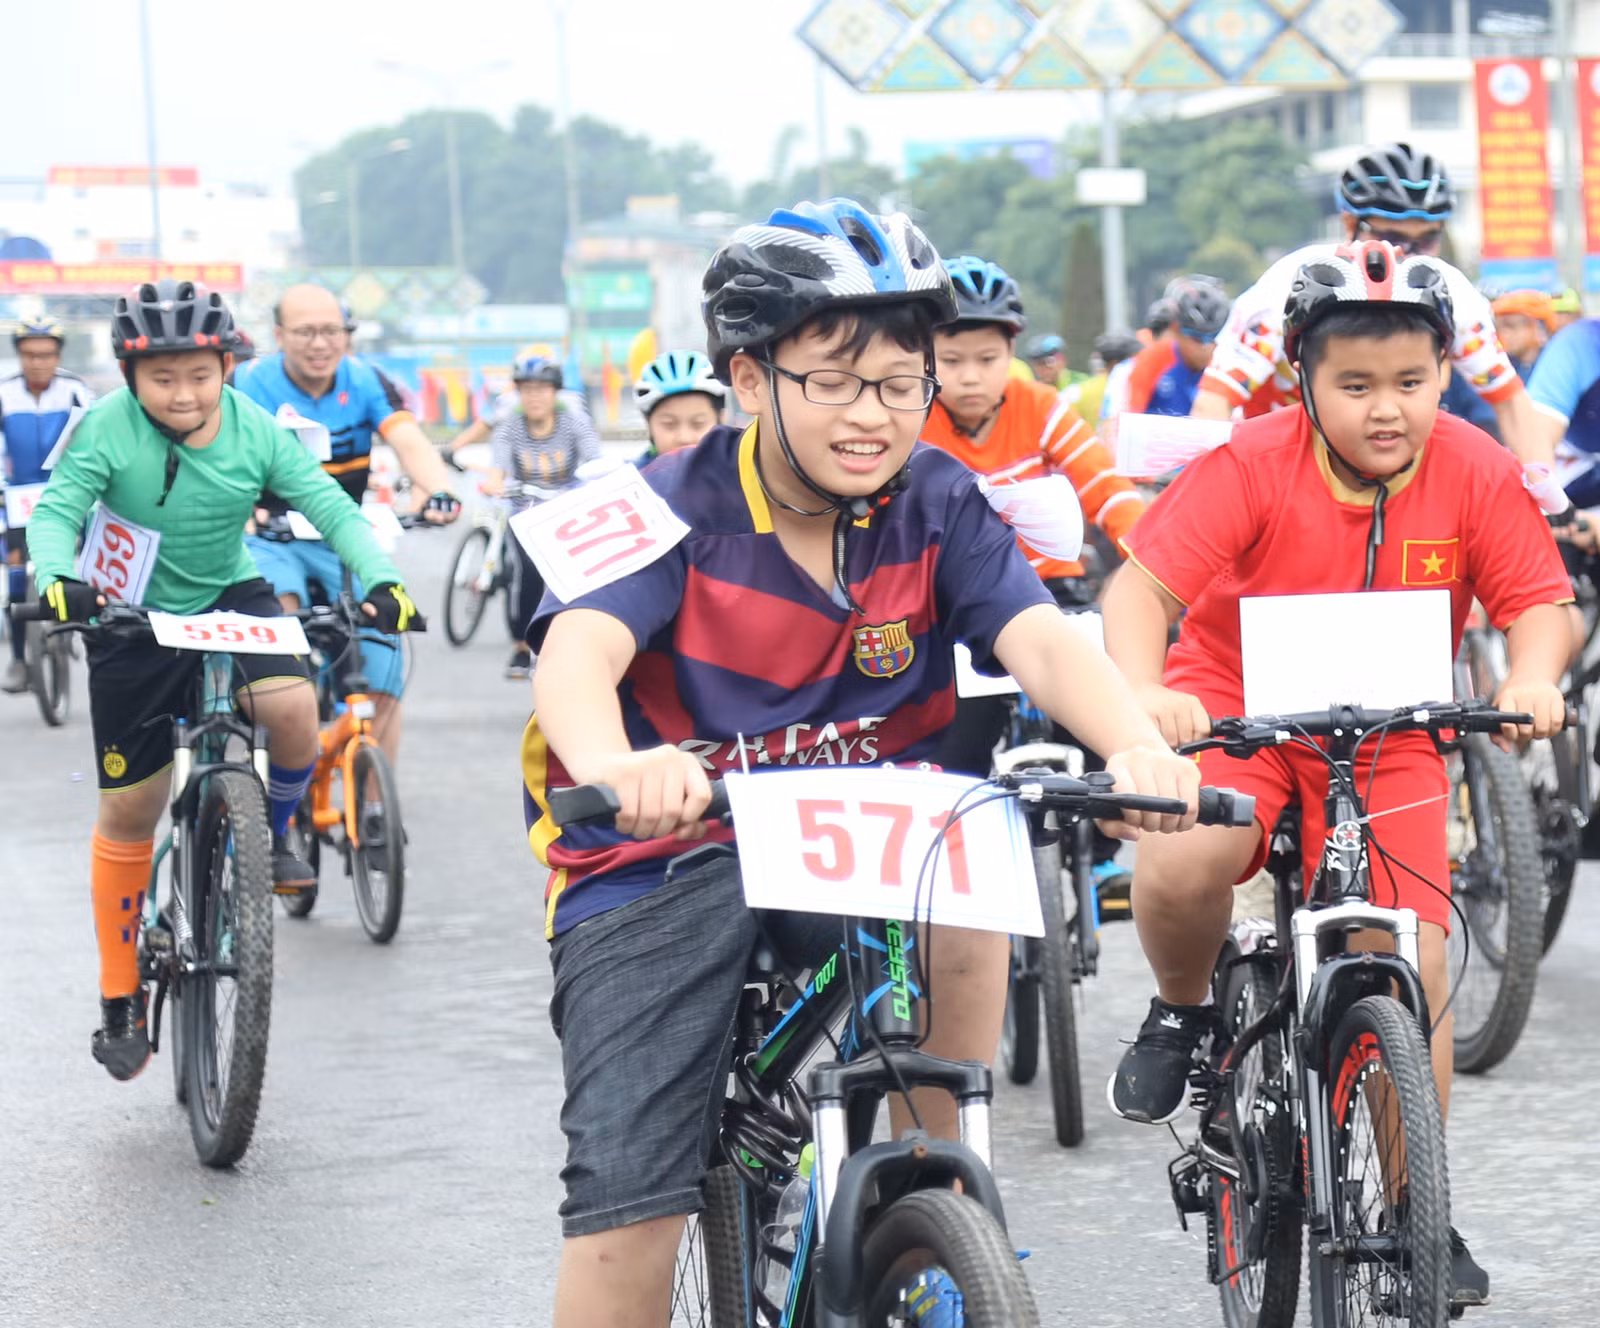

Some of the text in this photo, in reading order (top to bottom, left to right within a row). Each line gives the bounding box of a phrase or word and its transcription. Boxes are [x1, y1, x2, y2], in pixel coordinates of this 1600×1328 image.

[555, 498, 657, 577] 571
[183, 622, 278, 644] 559
[796, 798, 972, 896] 571
